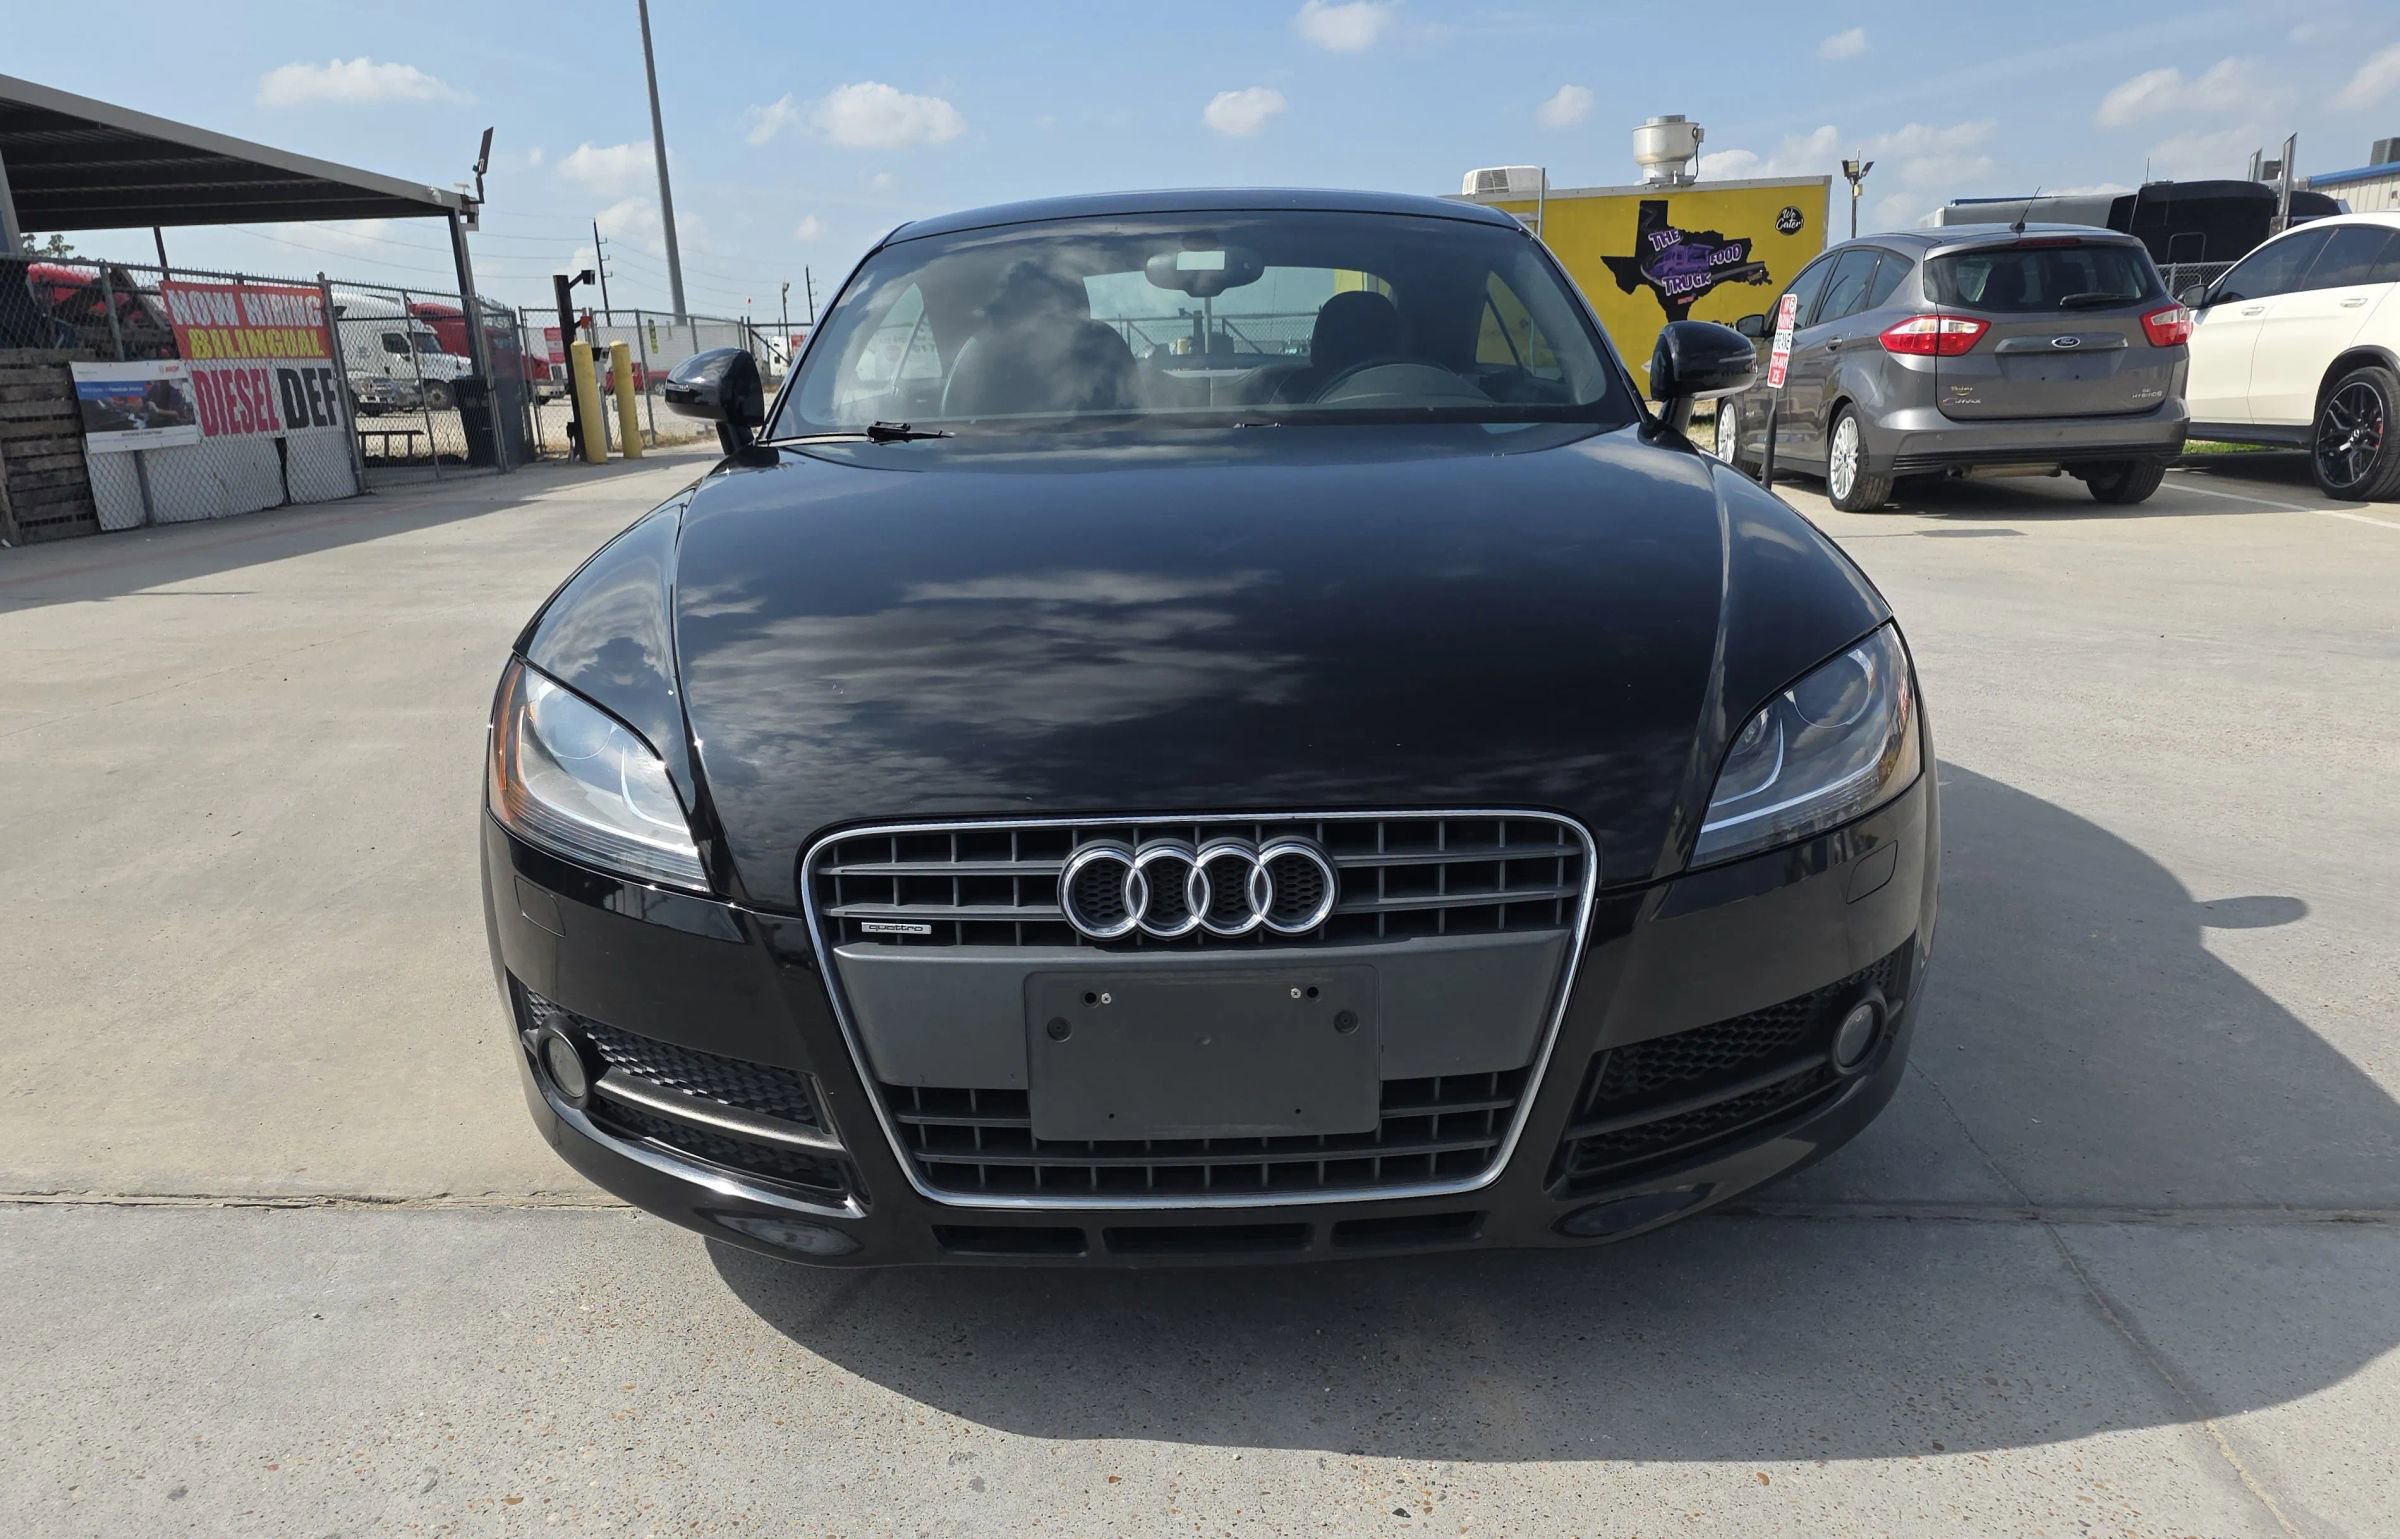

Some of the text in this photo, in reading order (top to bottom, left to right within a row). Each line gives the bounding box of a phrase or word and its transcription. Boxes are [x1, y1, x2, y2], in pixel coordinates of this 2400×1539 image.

[1782, 208, 1796, 218] We
[1648, 229, 1681, 251] THE
[1709, 243, 1742, 266] FOOD
[1661, 271, 1712, 297] TRUCK
[166, 288, 324, 327] NOW HIRING
[187, 327, 325, 359] BILINGUAL
[191, 367, 338, 437] DIESEL DEF
[868, 924, 924, 932] quattro
